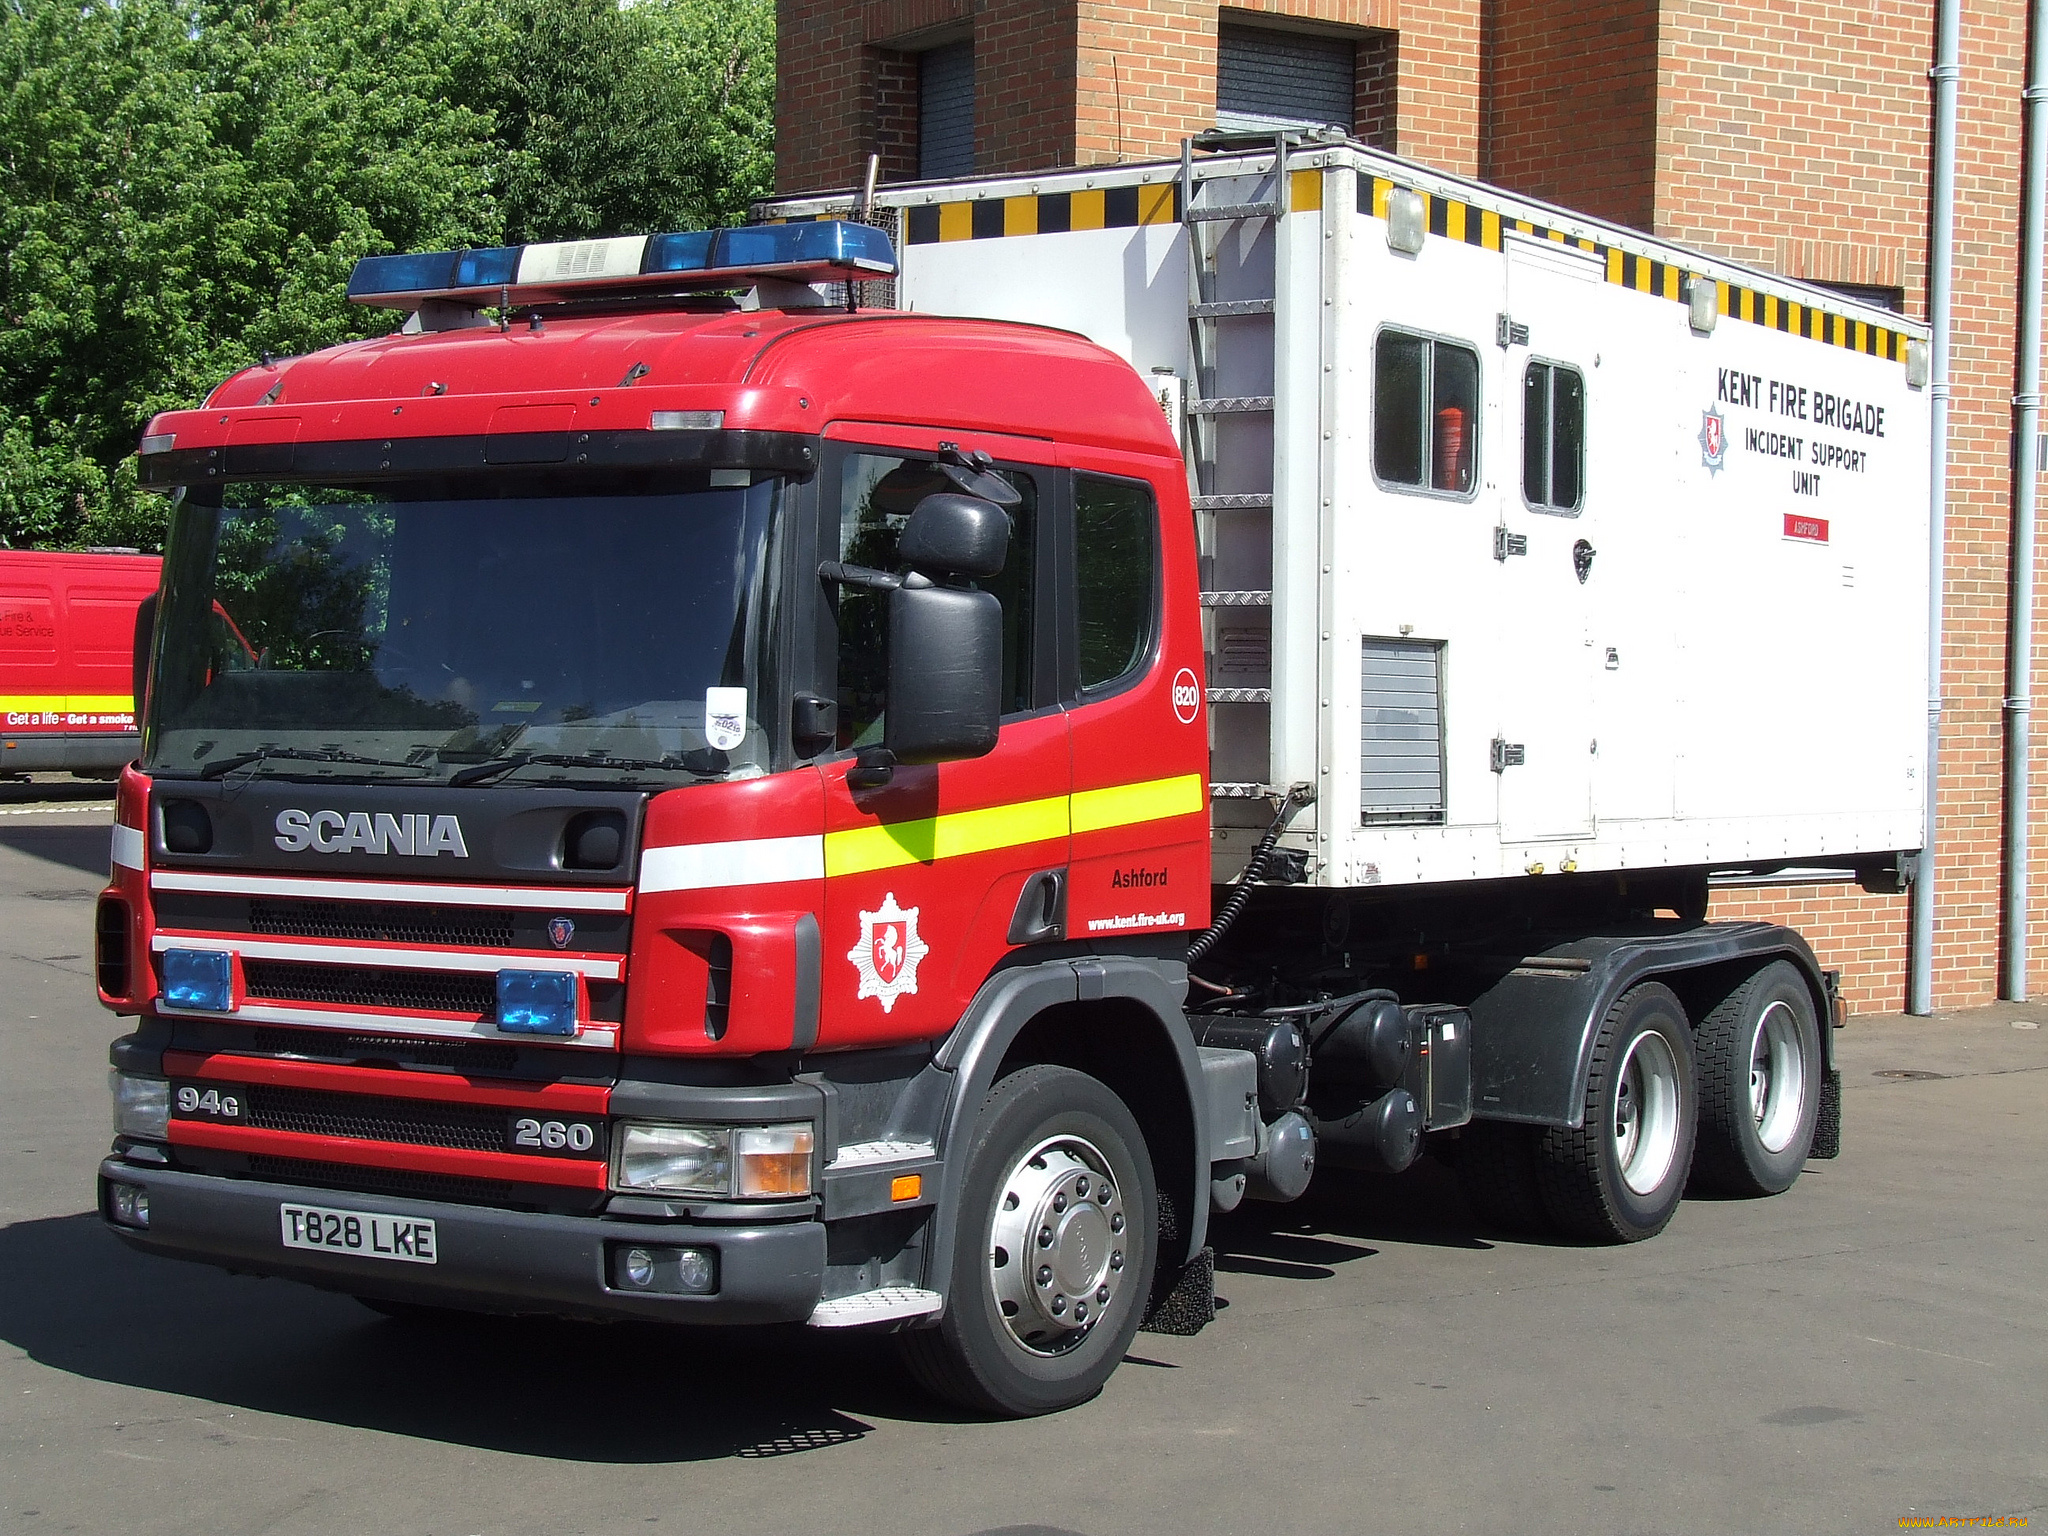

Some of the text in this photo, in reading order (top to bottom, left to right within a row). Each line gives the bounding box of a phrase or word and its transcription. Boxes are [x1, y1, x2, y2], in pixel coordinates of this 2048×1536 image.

[1718, 367, 1885, 438] KENT FIRE BRIGADE
[1745, 427, 1867, 473] INCIDENT SUPPORT
[1792, 470, 1820, 497] UNIT
[1794, 521, 1819, 537] ASHFORD
[5, 610, 33, 622] Fire &
[16, 625, 54, 637] Service
[1175, 686, 1197, 706] 820
[7, 712, 29, 725] Get
[31, 714, 39, 725] a
[42, 712, 59, 725] life
[67, 713, 87, 724] Get
[89, 715, 96, 724] a
[98, 714, 134, 724] smoke
[274, 809, 469, 858] SCANIA
[1112, 867, 1168, 888] Ashford
[1088, 912, 1185, 930] www.kent.fire-uk.org
[178, 1087, 239, 1116] 94G
[516, 1118, 594, 1151] 260
[286, 1209, 434, 1258] T828 LKE
